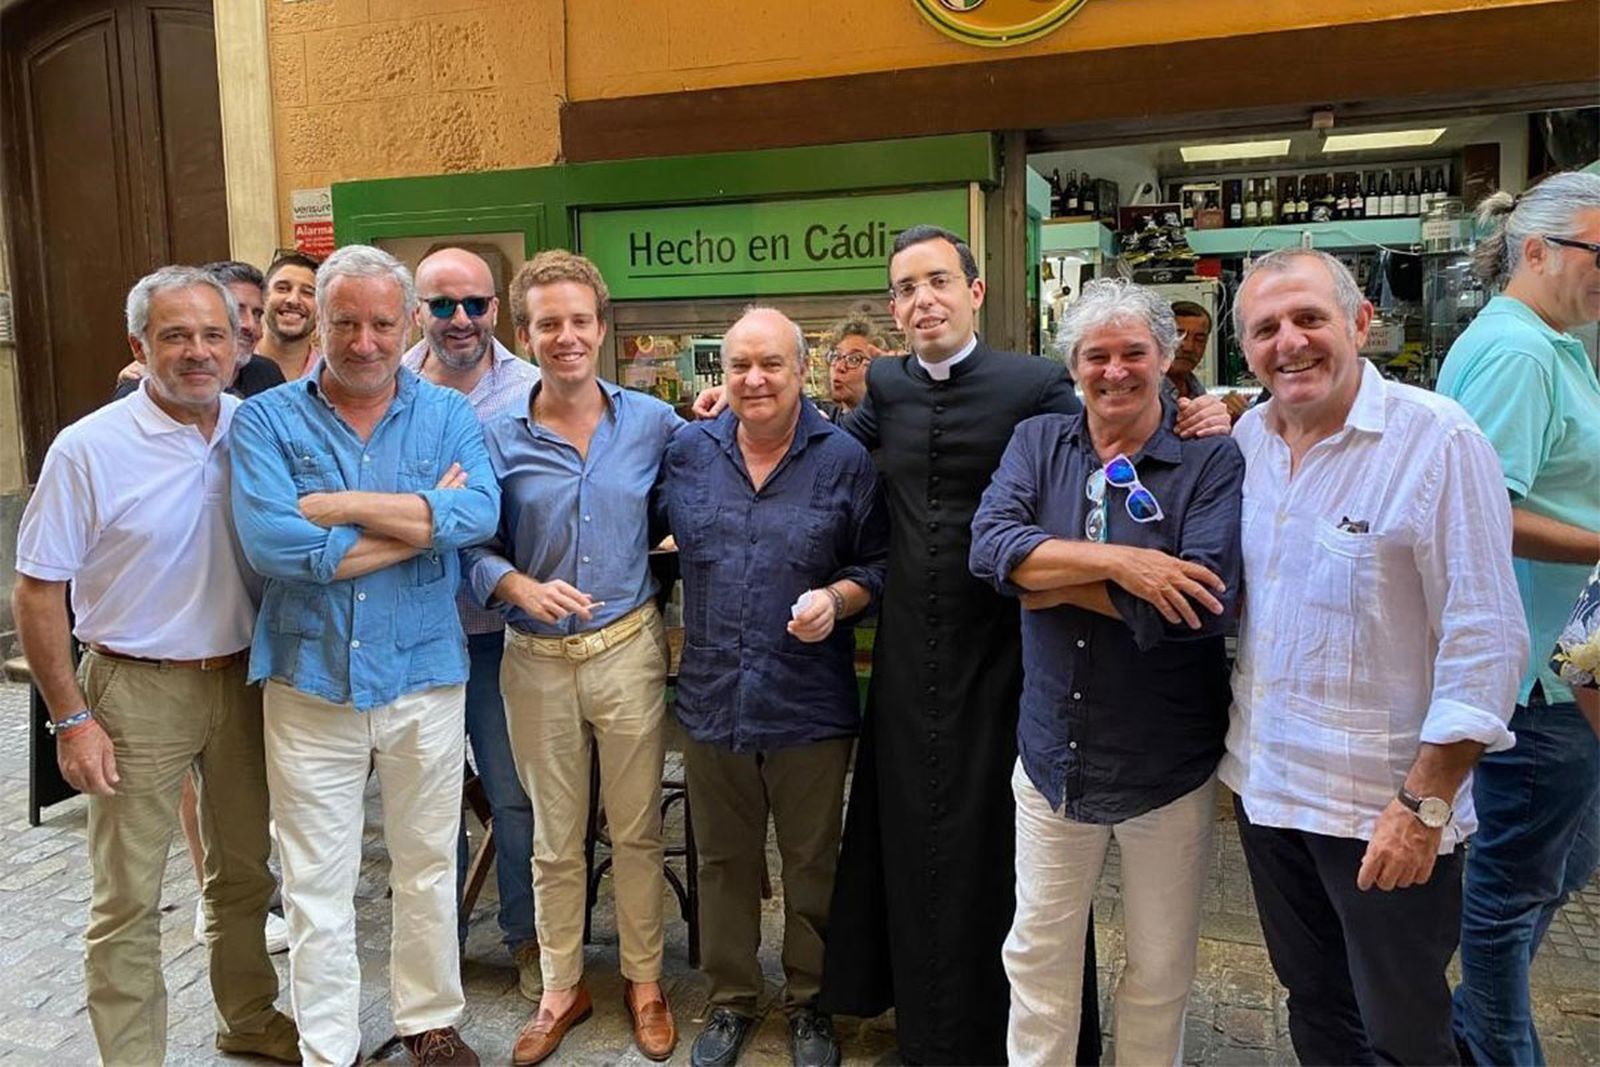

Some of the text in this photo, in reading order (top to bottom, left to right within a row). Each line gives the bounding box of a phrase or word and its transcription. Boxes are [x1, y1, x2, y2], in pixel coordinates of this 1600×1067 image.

[297, 225, 333, 235] Alarma
[629, 230, 736, 266] Hecho
[748, 231, 789, 262] en
